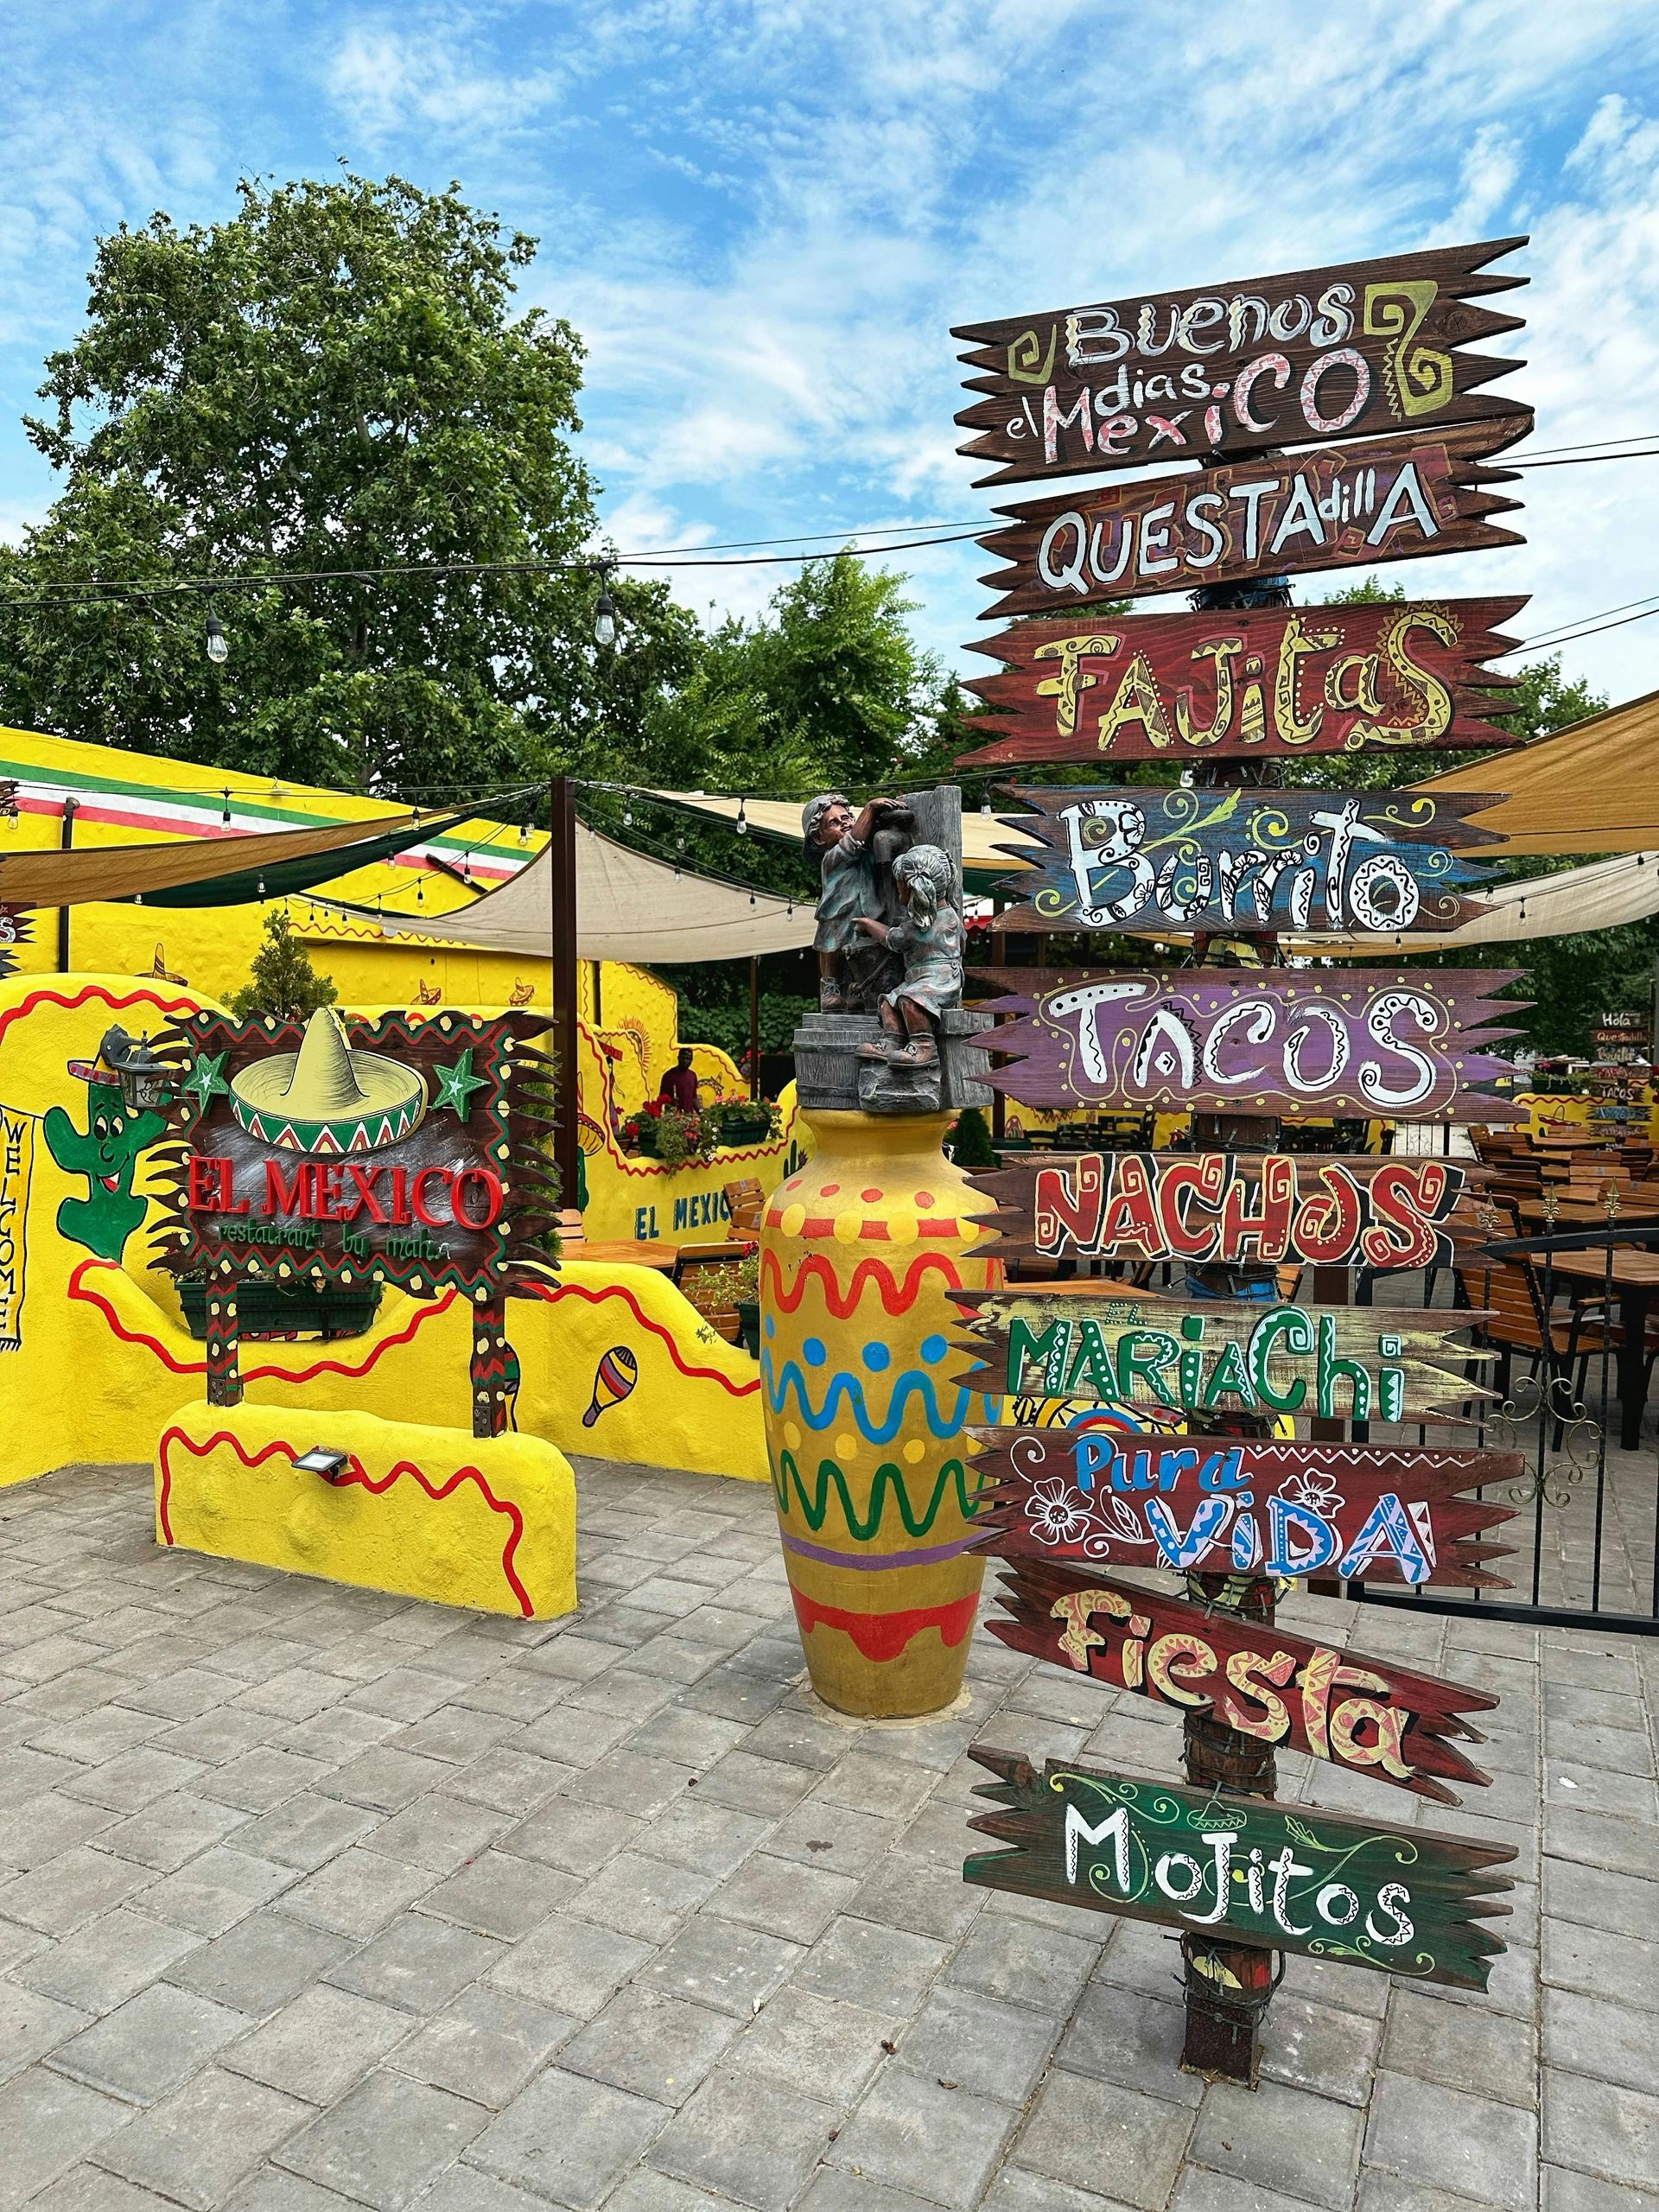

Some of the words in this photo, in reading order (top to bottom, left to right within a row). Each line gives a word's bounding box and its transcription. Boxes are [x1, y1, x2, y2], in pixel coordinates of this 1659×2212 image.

[1065, 283, 1355, 366] Buenos
[1007, 397, 1038, 438] el
[1095, 364, 1211, 416] dias
[1038, 461, 1441, 594] QUESTAdillA
[1057, 798, 1420, 931] Burrito
[1049, 983, 1439, 1108] TACOS
[1603, 1013, 1630, 1027] Hola
[1599, 1084, 1634, 1100] TACOS
[186, 1156, 250, 1213] EL
[261, 1160, 504, 1230] MEXICO
[635, 1206, 659, 1240] EL
[673, 1192, 729, 1231] MEXIC
[1035, 1154, 1448, 1268] NACHOS
[218, 1218, 325, 1250] restaurant
[342, 1224, 370, 1257] by
[1105, 1300, 1148, 1325] EL
[1069, 1434, 1252, 1493] Pura
[1050, 1588, 1415, 1779] Fiesta
